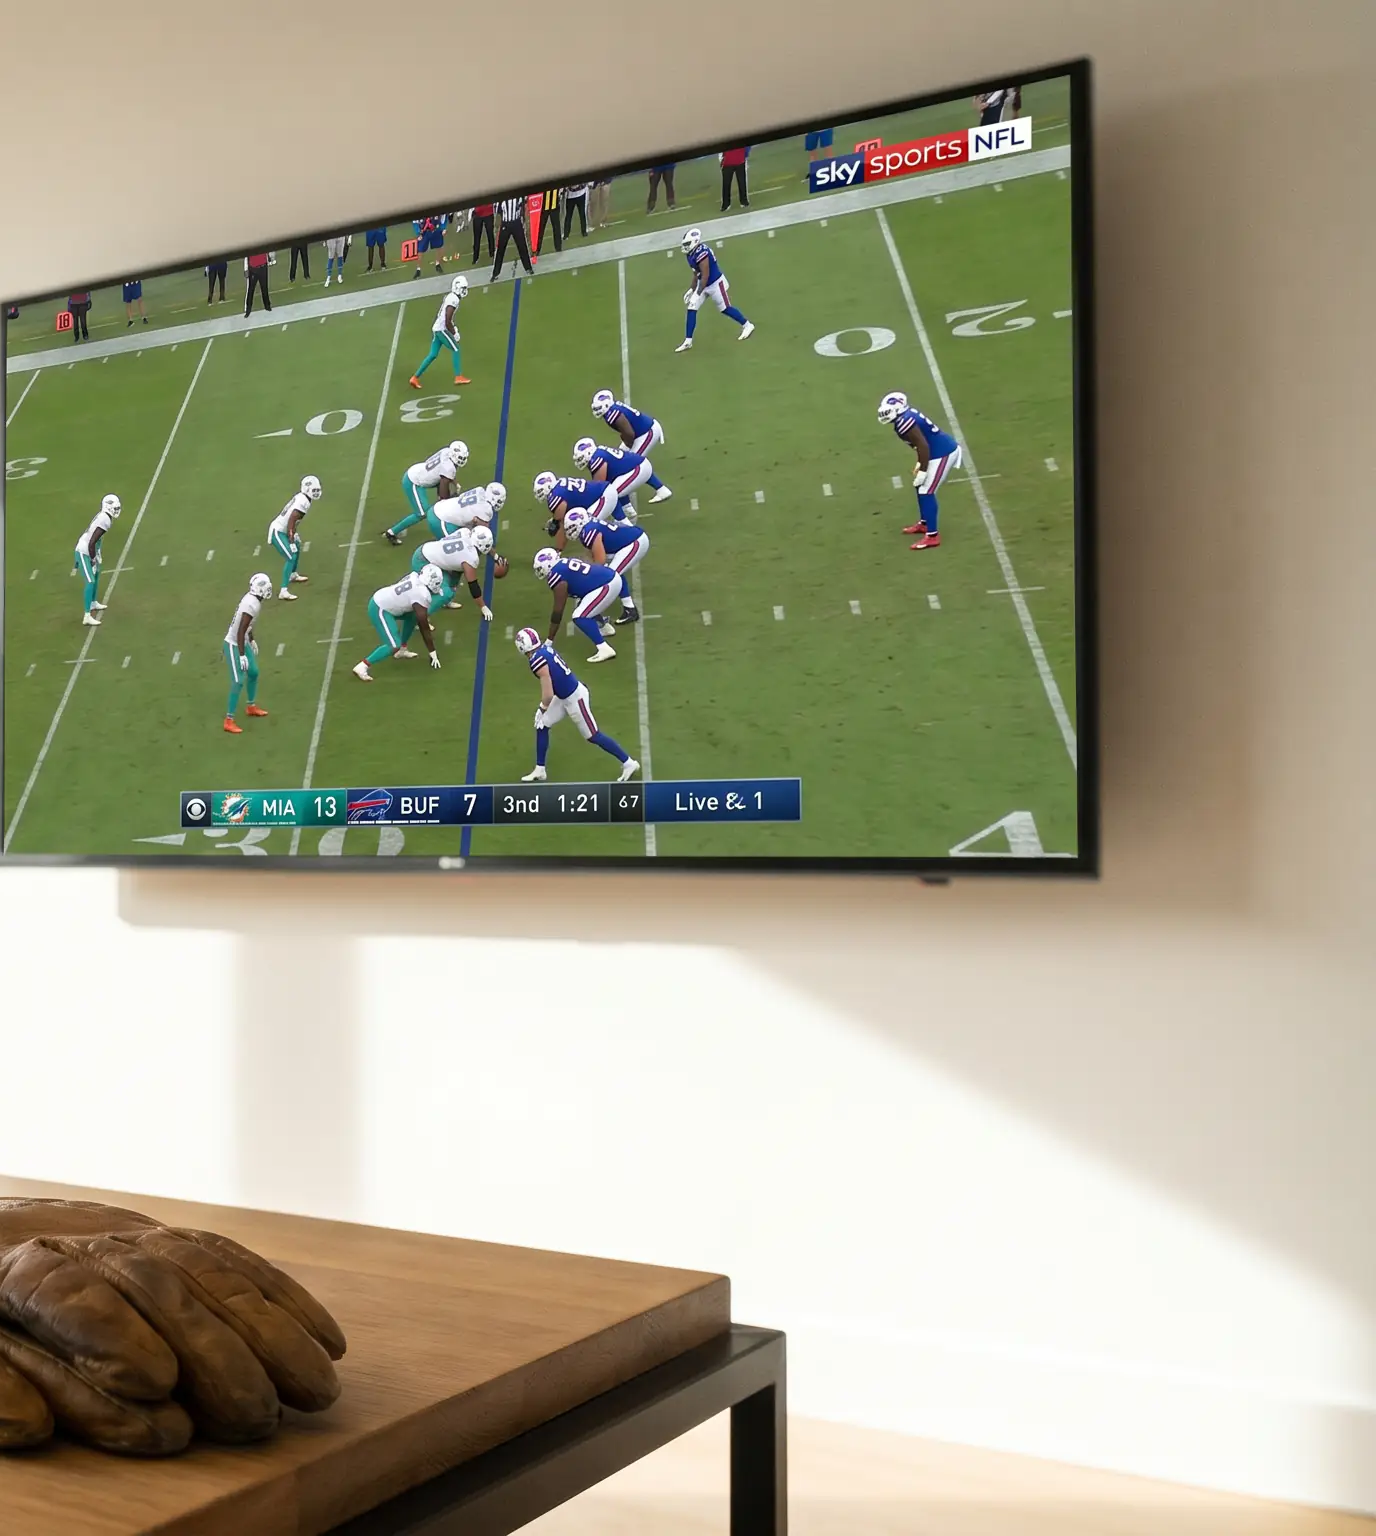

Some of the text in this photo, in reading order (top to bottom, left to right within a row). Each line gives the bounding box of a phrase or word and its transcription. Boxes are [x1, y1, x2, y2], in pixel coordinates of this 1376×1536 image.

[815, 159, 860, 186] sky
[870, 138, 962, 176] sports
[975, 126, 1025, 153] NFL
[262, 799, 296, 816] MIA
[314, 796, 337, 818] 13
[400, 796, 440, 815] BUF
[463, 793, 477, 816] 7
[503, 795, 539, 814] 3nd
[557, 793, 598, 813] 1:21
[676, 793, 719, 811] Live
[754, 791, 762, 810] 1
